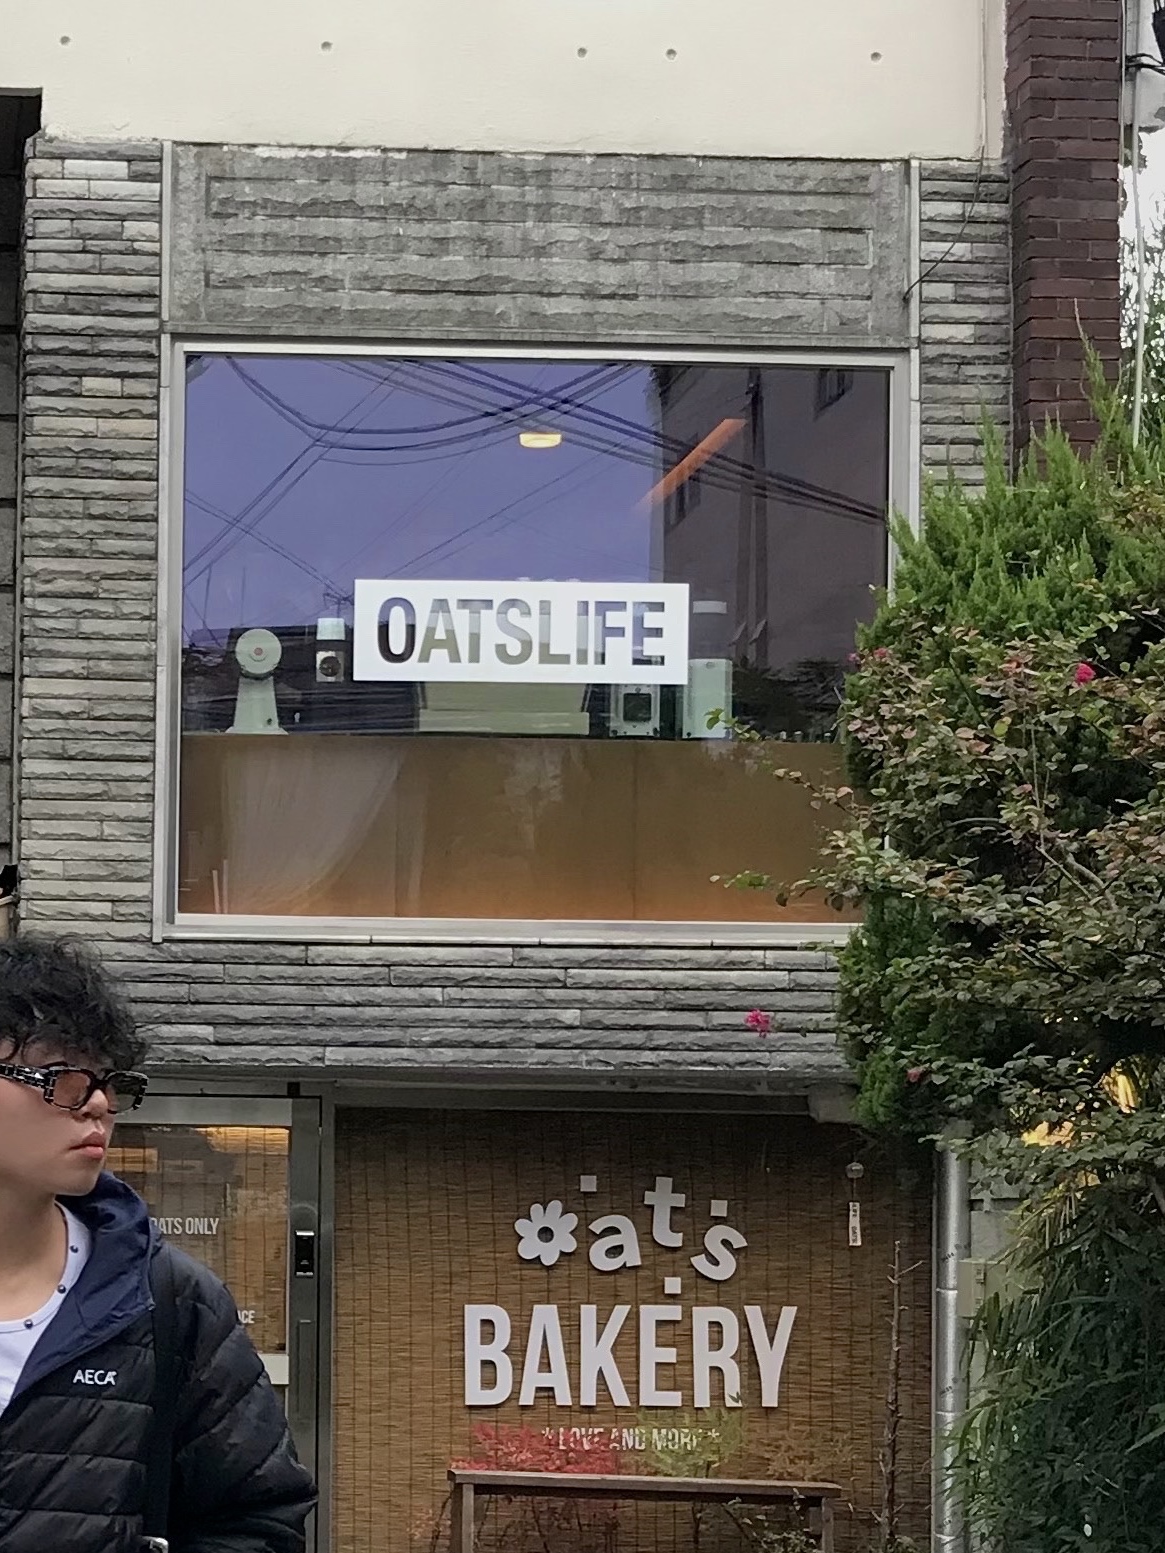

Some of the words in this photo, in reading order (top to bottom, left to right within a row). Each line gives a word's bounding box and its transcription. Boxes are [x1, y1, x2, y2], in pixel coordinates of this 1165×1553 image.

[377, 597, 666, 666] OATSLIFE
[185, 1217, 220, 1235] ONLY
[464, 1303, 798, 1408] BAKERY
[609, 1427, 646, 1450] AND
